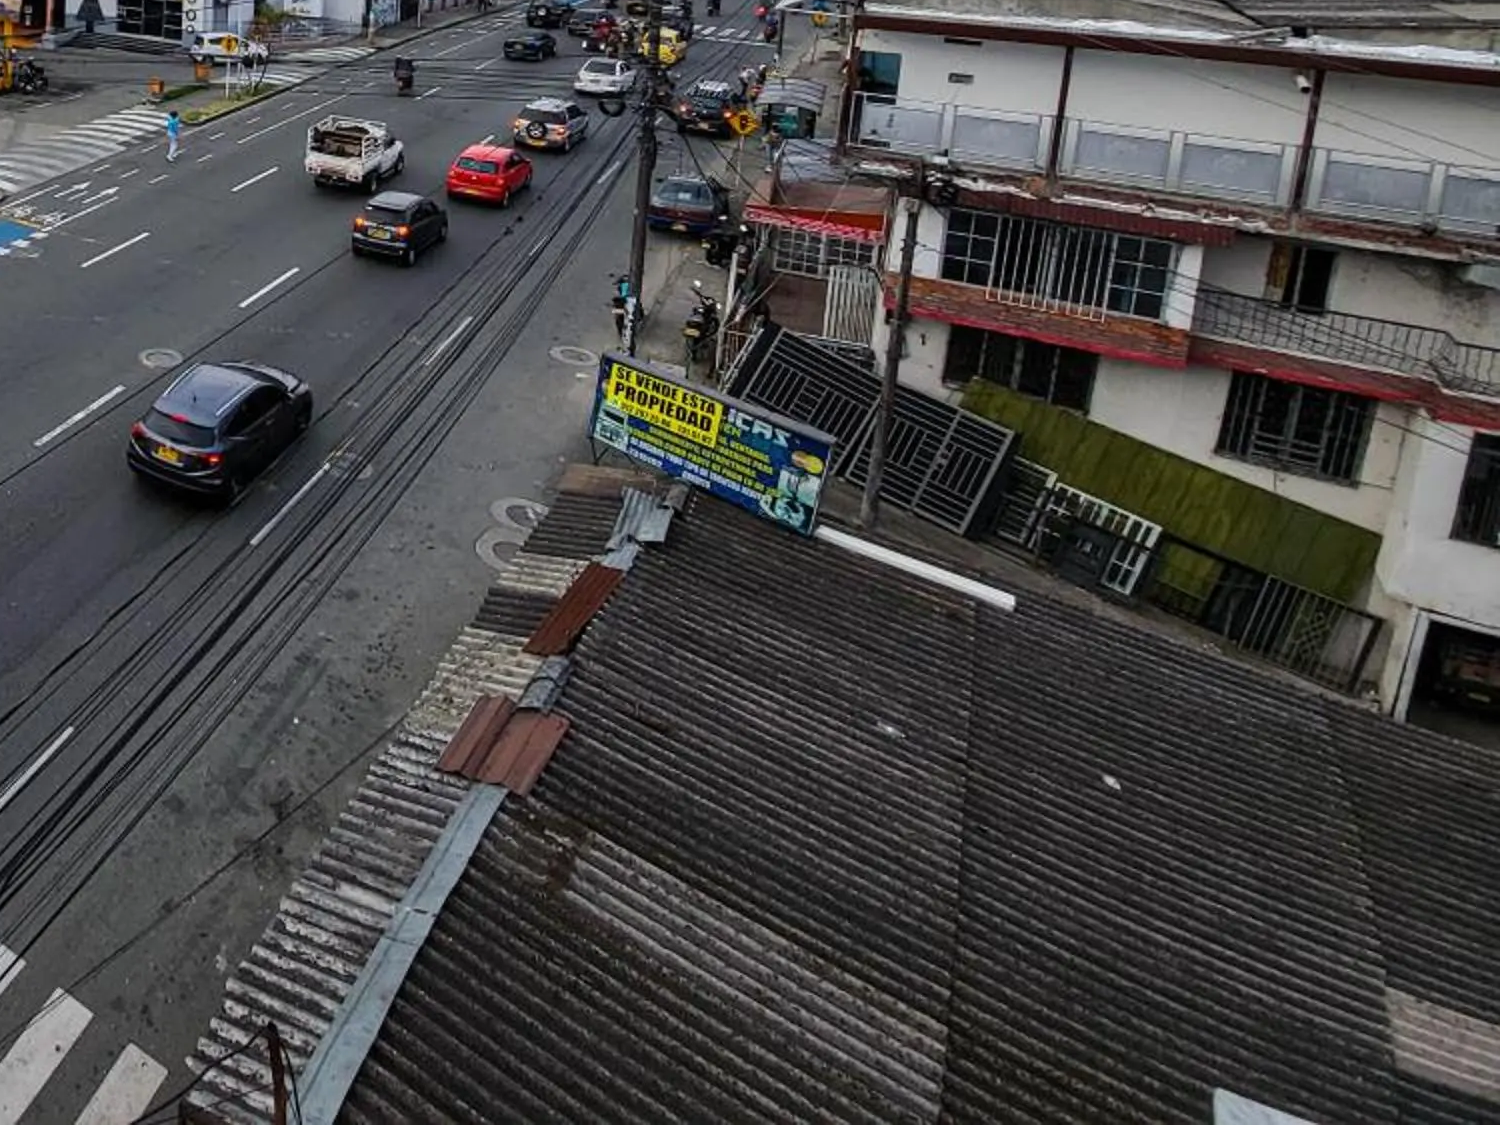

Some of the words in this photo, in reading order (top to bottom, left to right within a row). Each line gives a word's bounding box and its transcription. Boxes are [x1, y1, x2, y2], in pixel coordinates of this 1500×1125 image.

[613, 380, 713, 433] PROPIEDAD
[617, 366, 634, 382] SE
[636, 371, 678, 400] VENDE
[681, 389, 716, 416] ESTA
